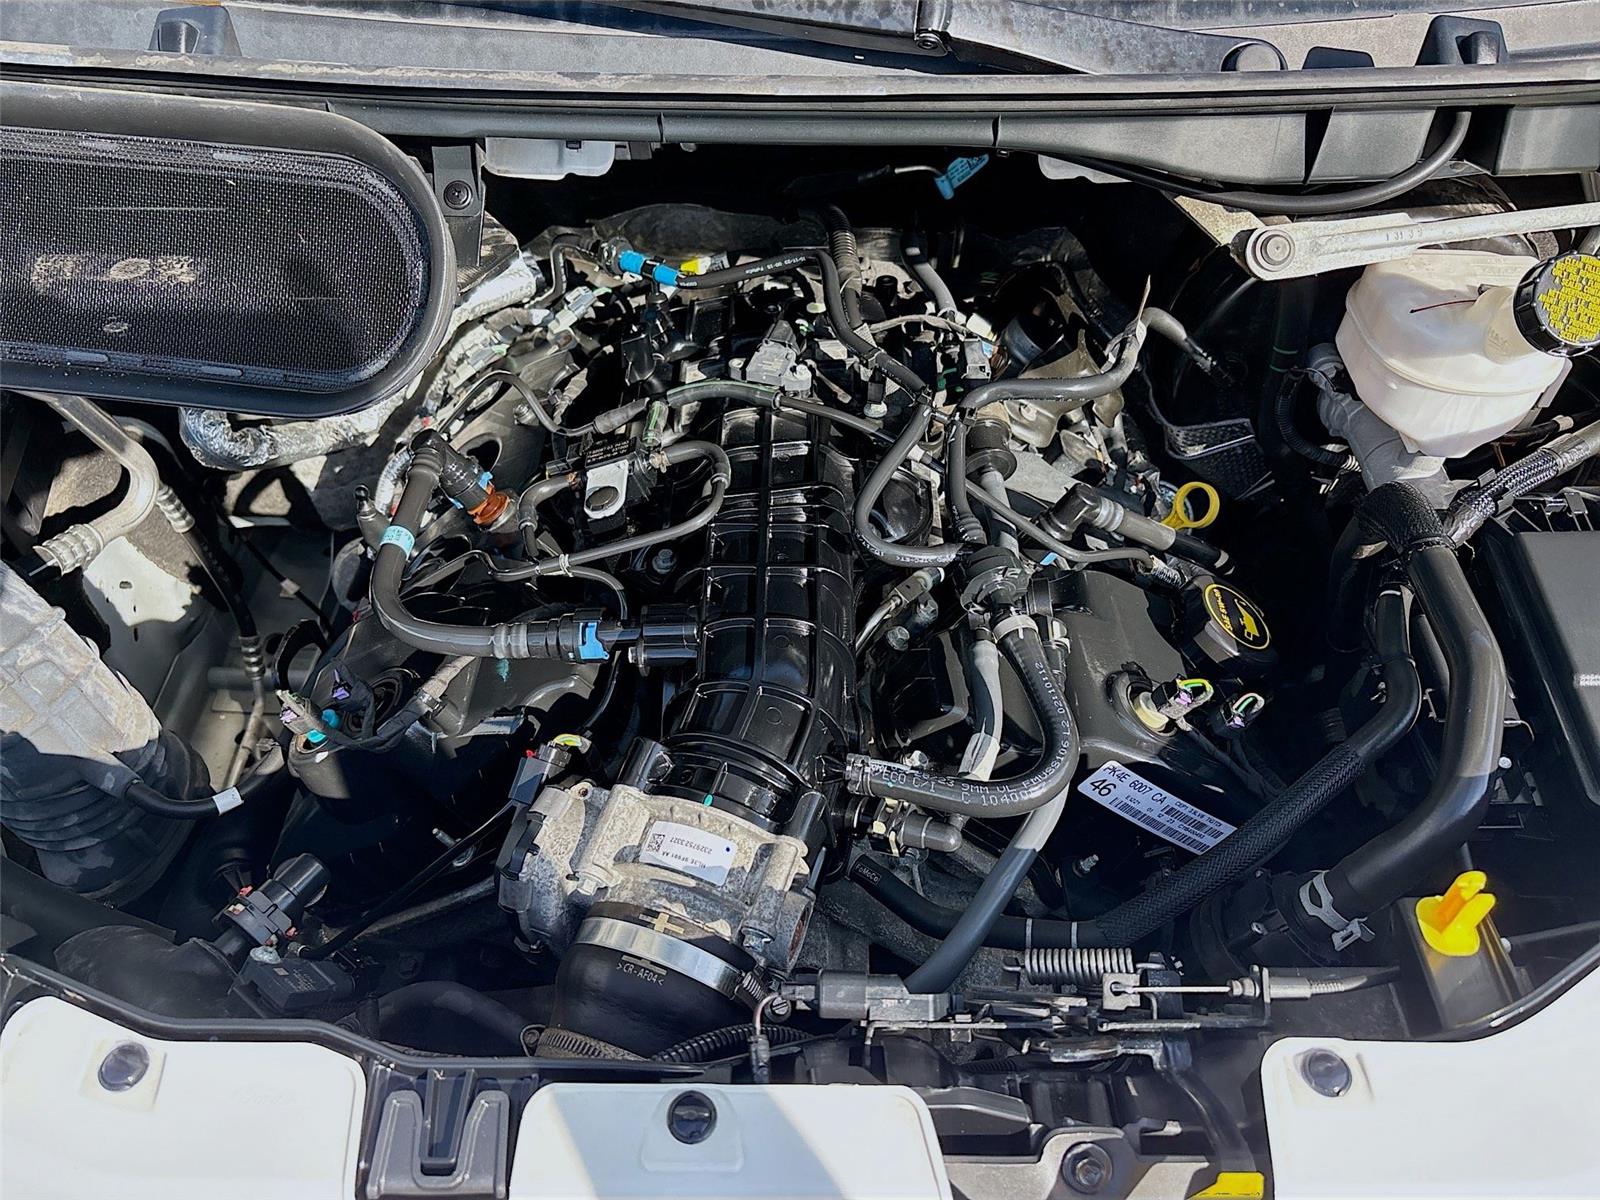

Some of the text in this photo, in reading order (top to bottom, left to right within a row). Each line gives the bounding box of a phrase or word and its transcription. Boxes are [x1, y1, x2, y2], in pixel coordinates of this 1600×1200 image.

[961, 783, 989, 794] 9MM
[1089, 778, 1117, 797] 46
[1129, 779, 1153, 797] 6007
[1151, 792, 1168, 805] CA
